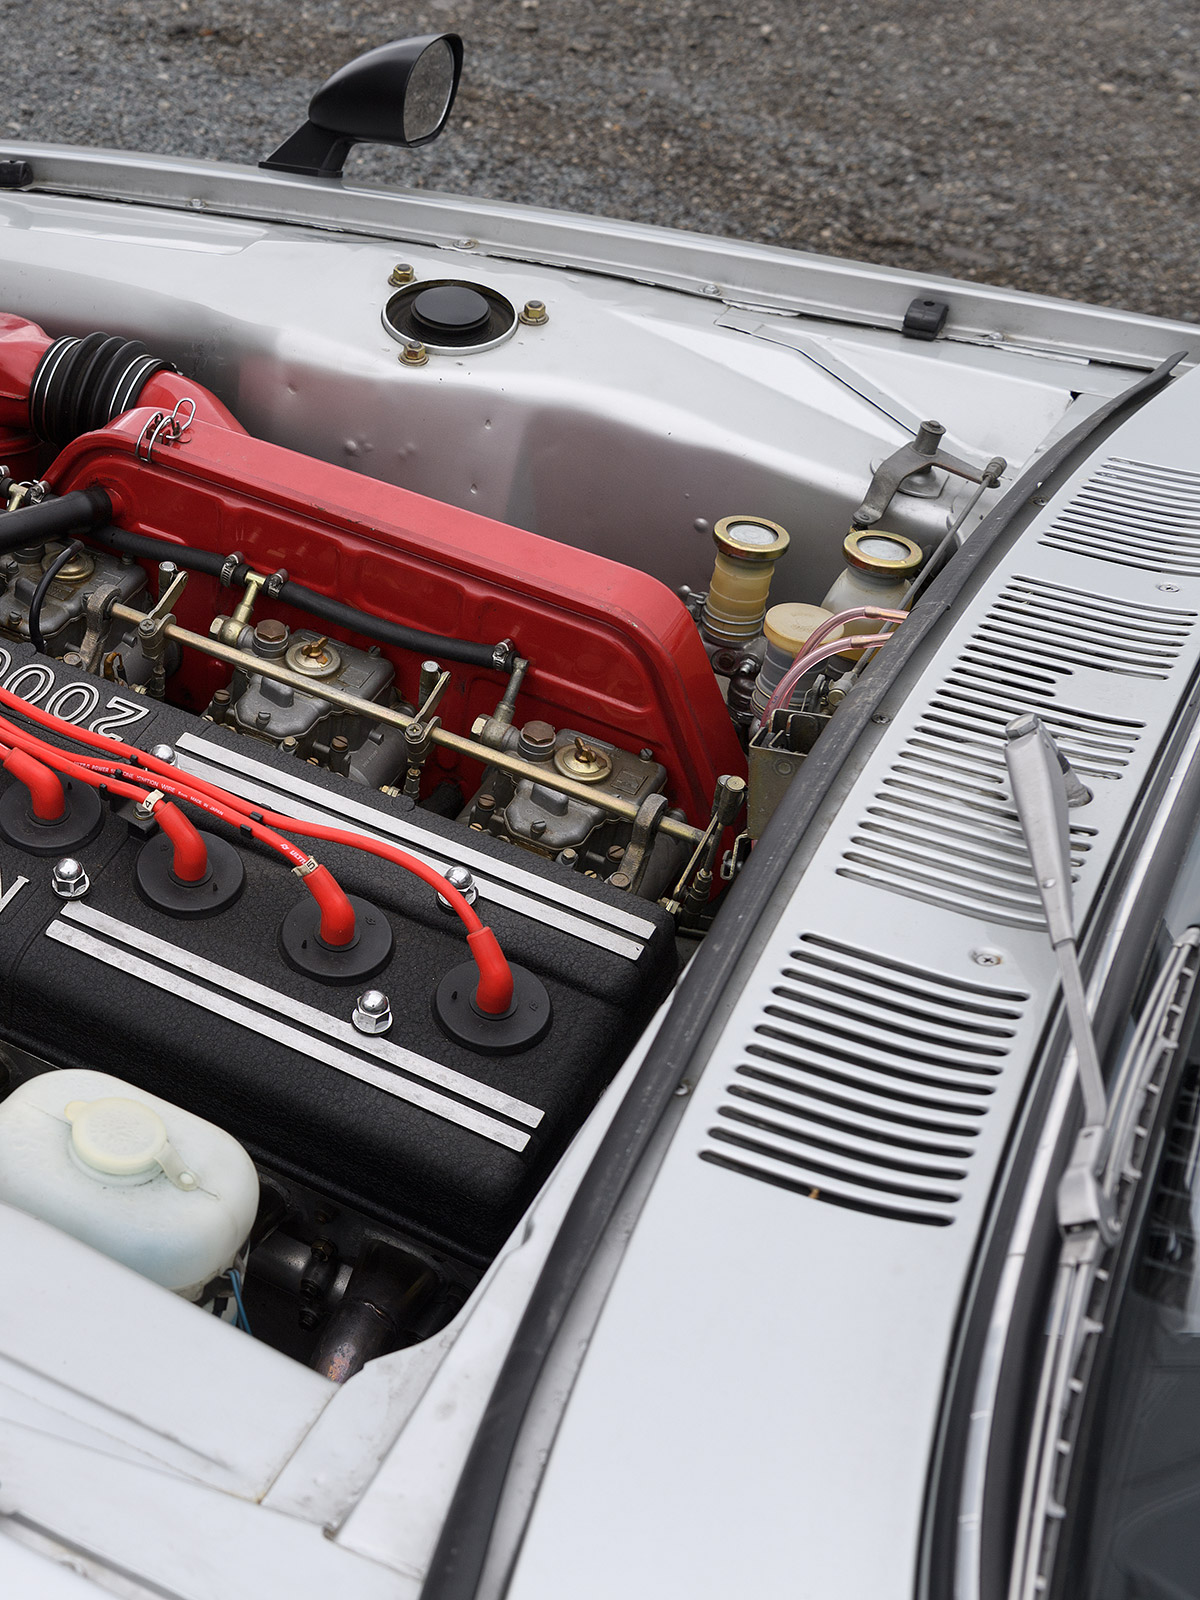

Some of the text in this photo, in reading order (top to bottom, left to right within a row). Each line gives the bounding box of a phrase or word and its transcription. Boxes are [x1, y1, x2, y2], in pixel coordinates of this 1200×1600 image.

[91, 765, 109, 773] POWER
[137, 775, 159, 787] IGNITION
[161, 784, 175, 793] WIRE
[190, 796, 203, 805] MADE
[210, 806, 224, 816] JAPAN
[307, 860, 316, 870] 5
